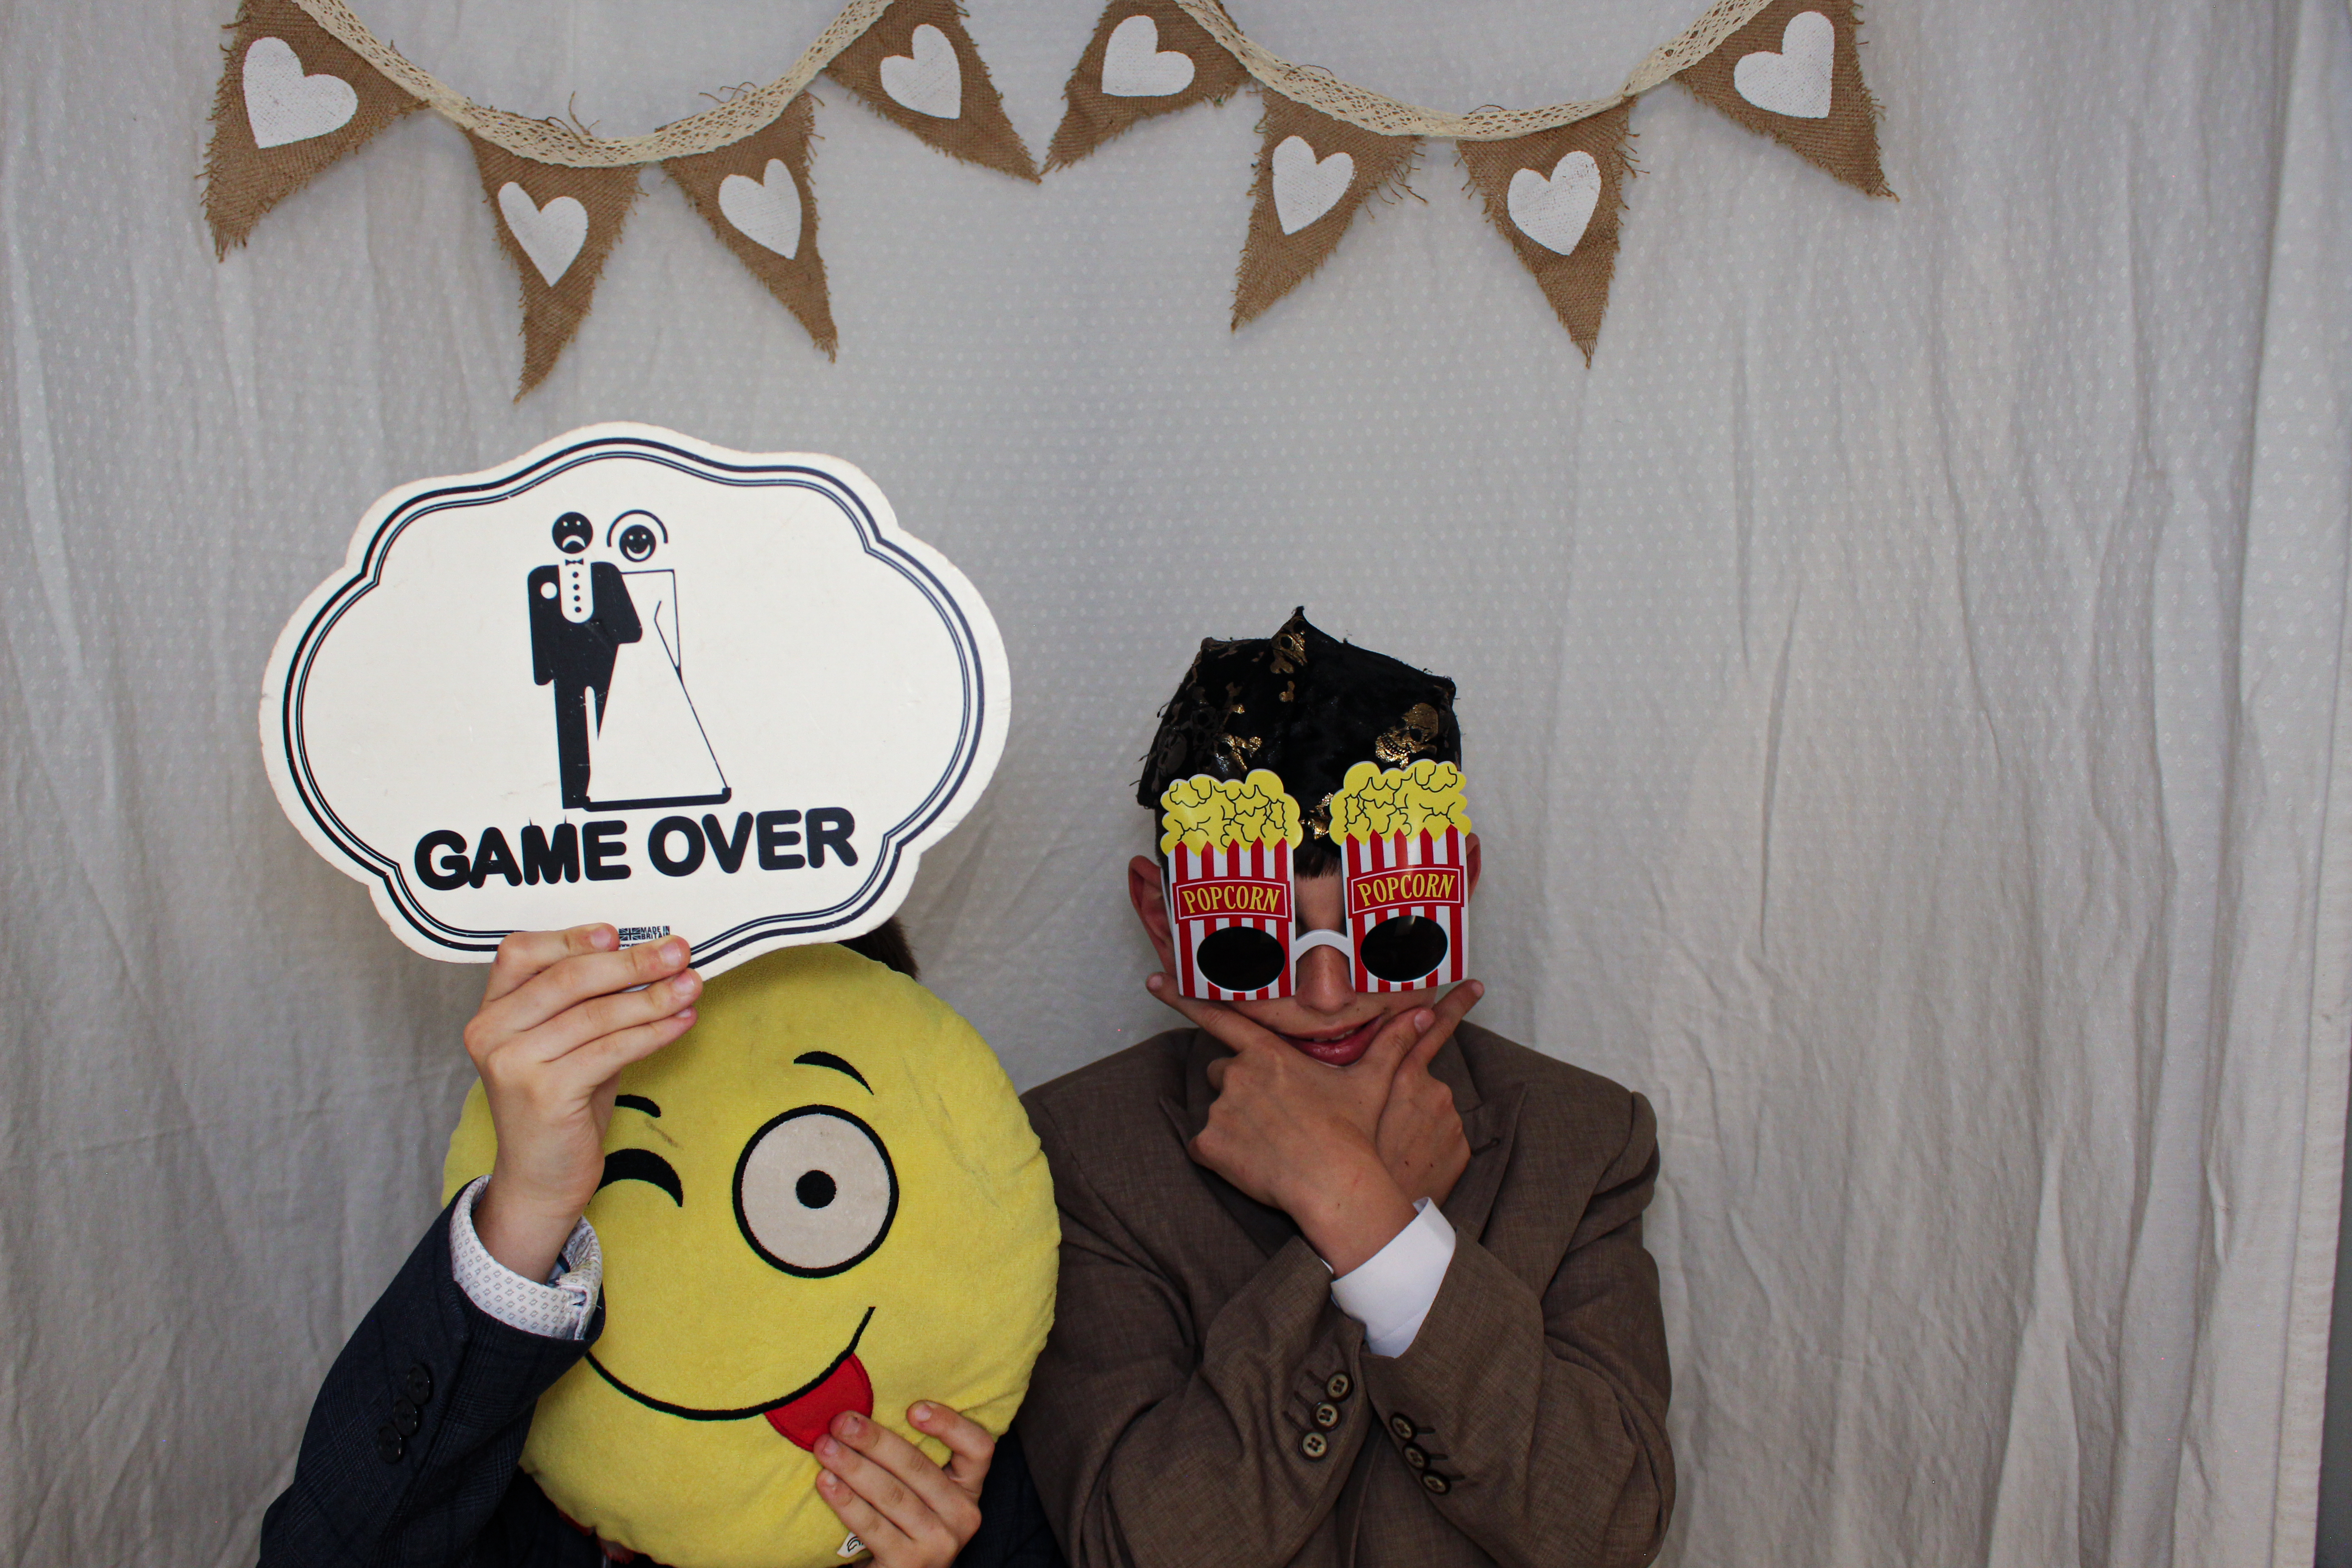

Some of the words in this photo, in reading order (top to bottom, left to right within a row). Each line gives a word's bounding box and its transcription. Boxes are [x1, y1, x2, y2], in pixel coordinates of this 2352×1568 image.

[414, 818, 632, 891] GAME
[648, 807, 858, 877] OVER
[1182, 885, 1281, 914] POPCORN
[1357, 873, 1456, 907] POPCORN
